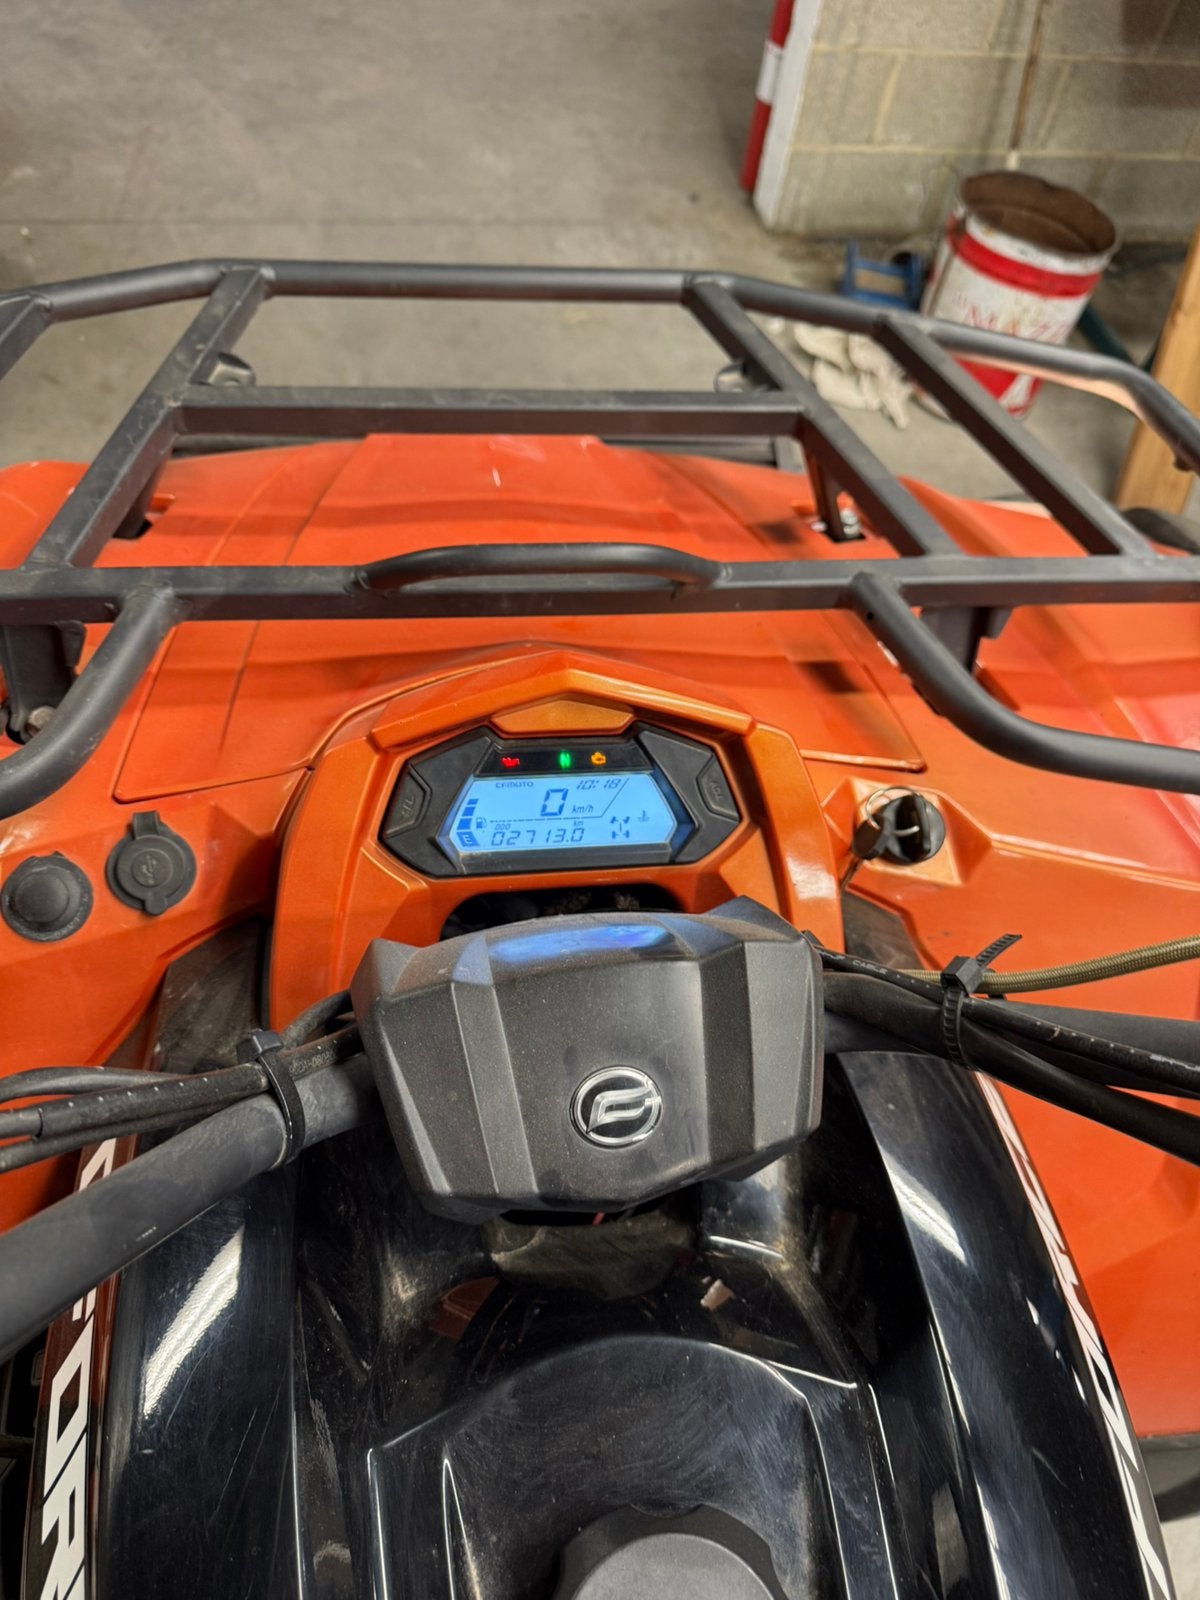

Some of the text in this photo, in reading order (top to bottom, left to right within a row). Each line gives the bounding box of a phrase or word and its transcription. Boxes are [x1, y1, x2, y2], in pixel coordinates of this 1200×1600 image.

[495, 778, 622, 791] CFMOTO 10:18
[540, 788, 594, 817] 0 km/h
[491, 828, 585, 846] 02713.0
